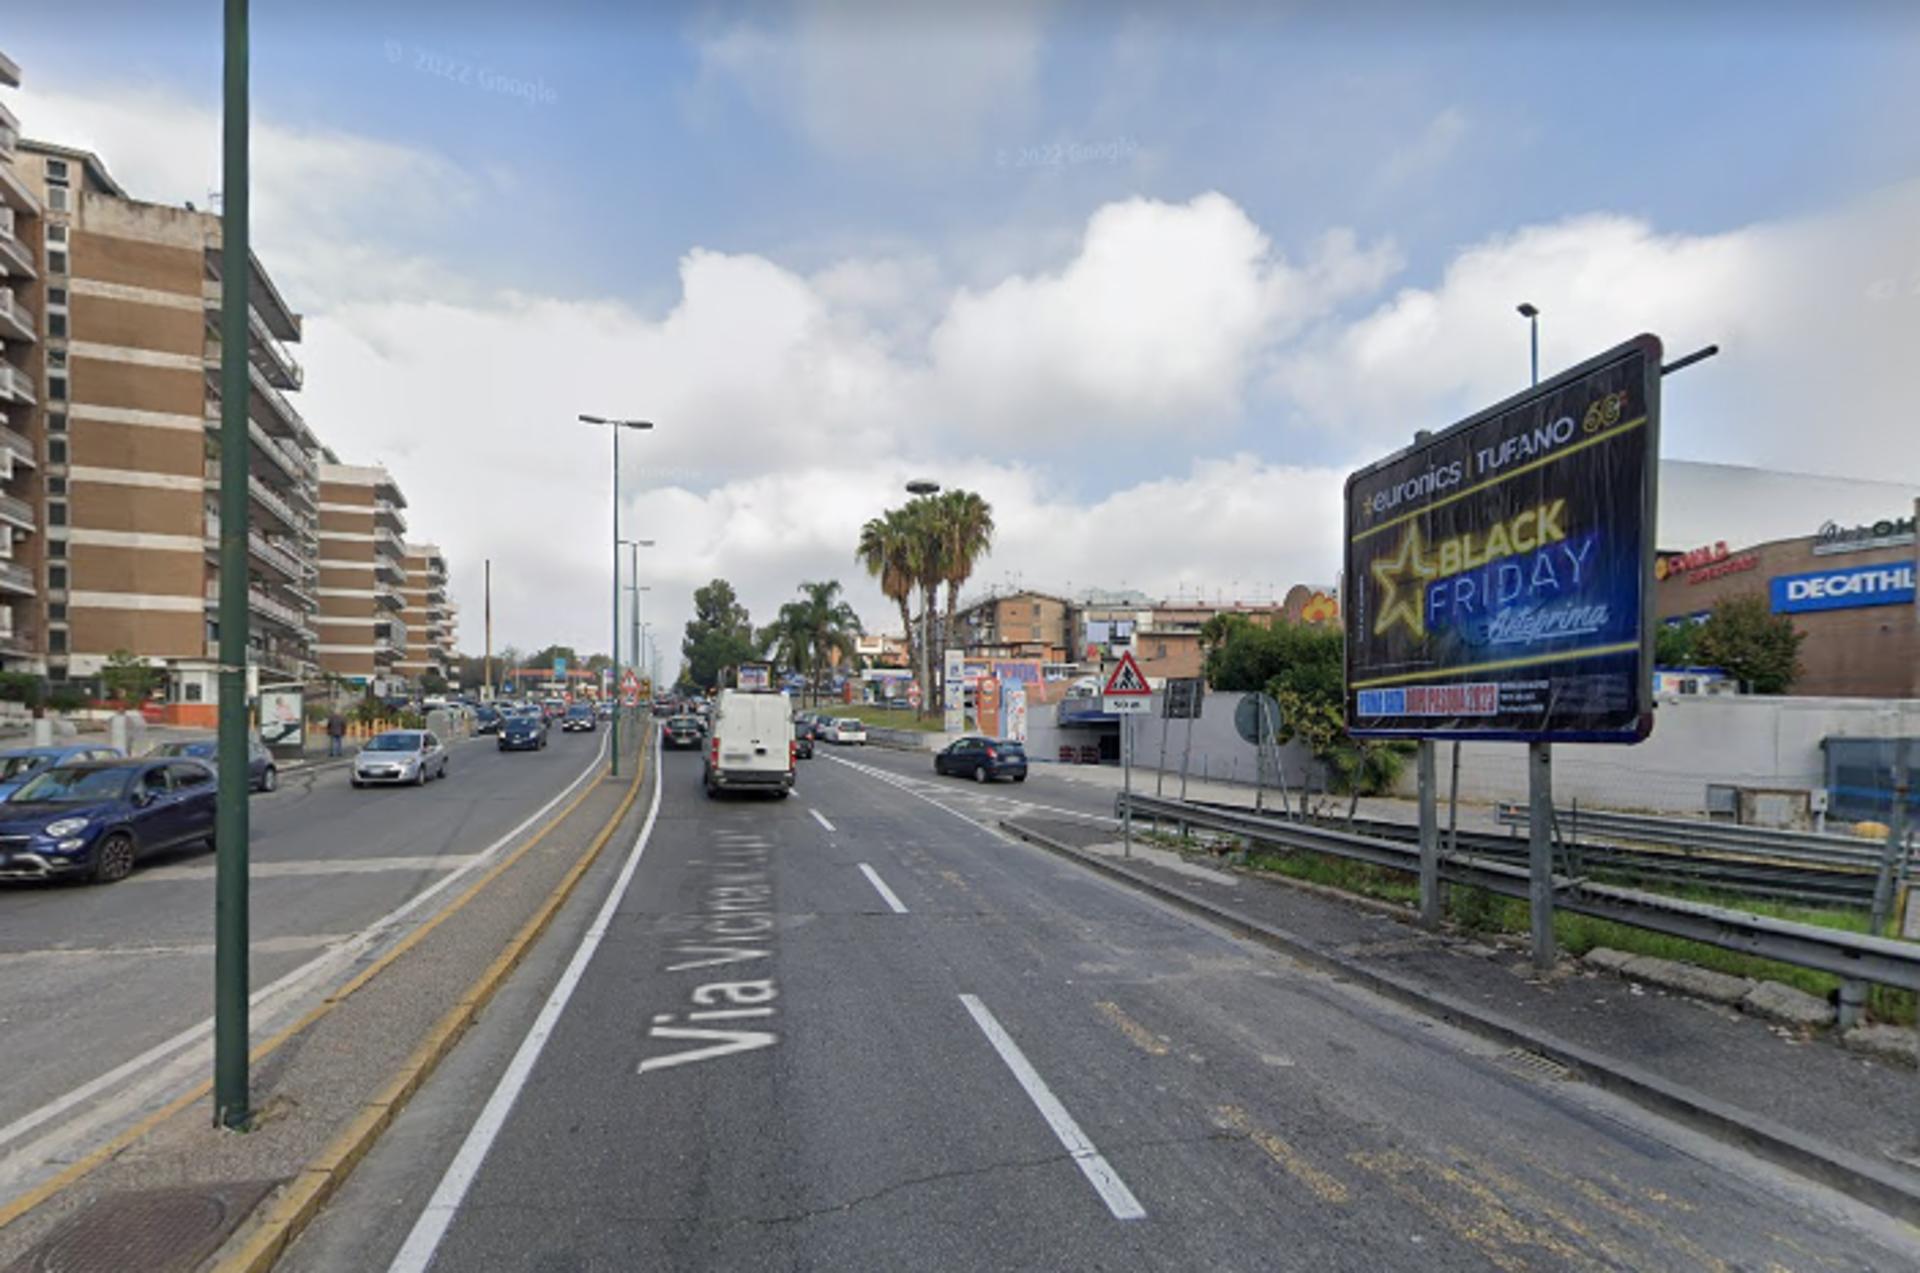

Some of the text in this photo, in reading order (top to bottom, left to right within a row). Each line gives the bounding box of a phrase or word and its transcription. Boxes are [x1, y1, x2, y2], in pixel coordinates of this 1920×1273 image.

[1374, 461, 1461, 512] euronics
[1476, 416, 1574, 475] TUFANO
[1441, 501, 1566, 574] BLACK
[1430, 541, 1590, 620] FRIDAY
